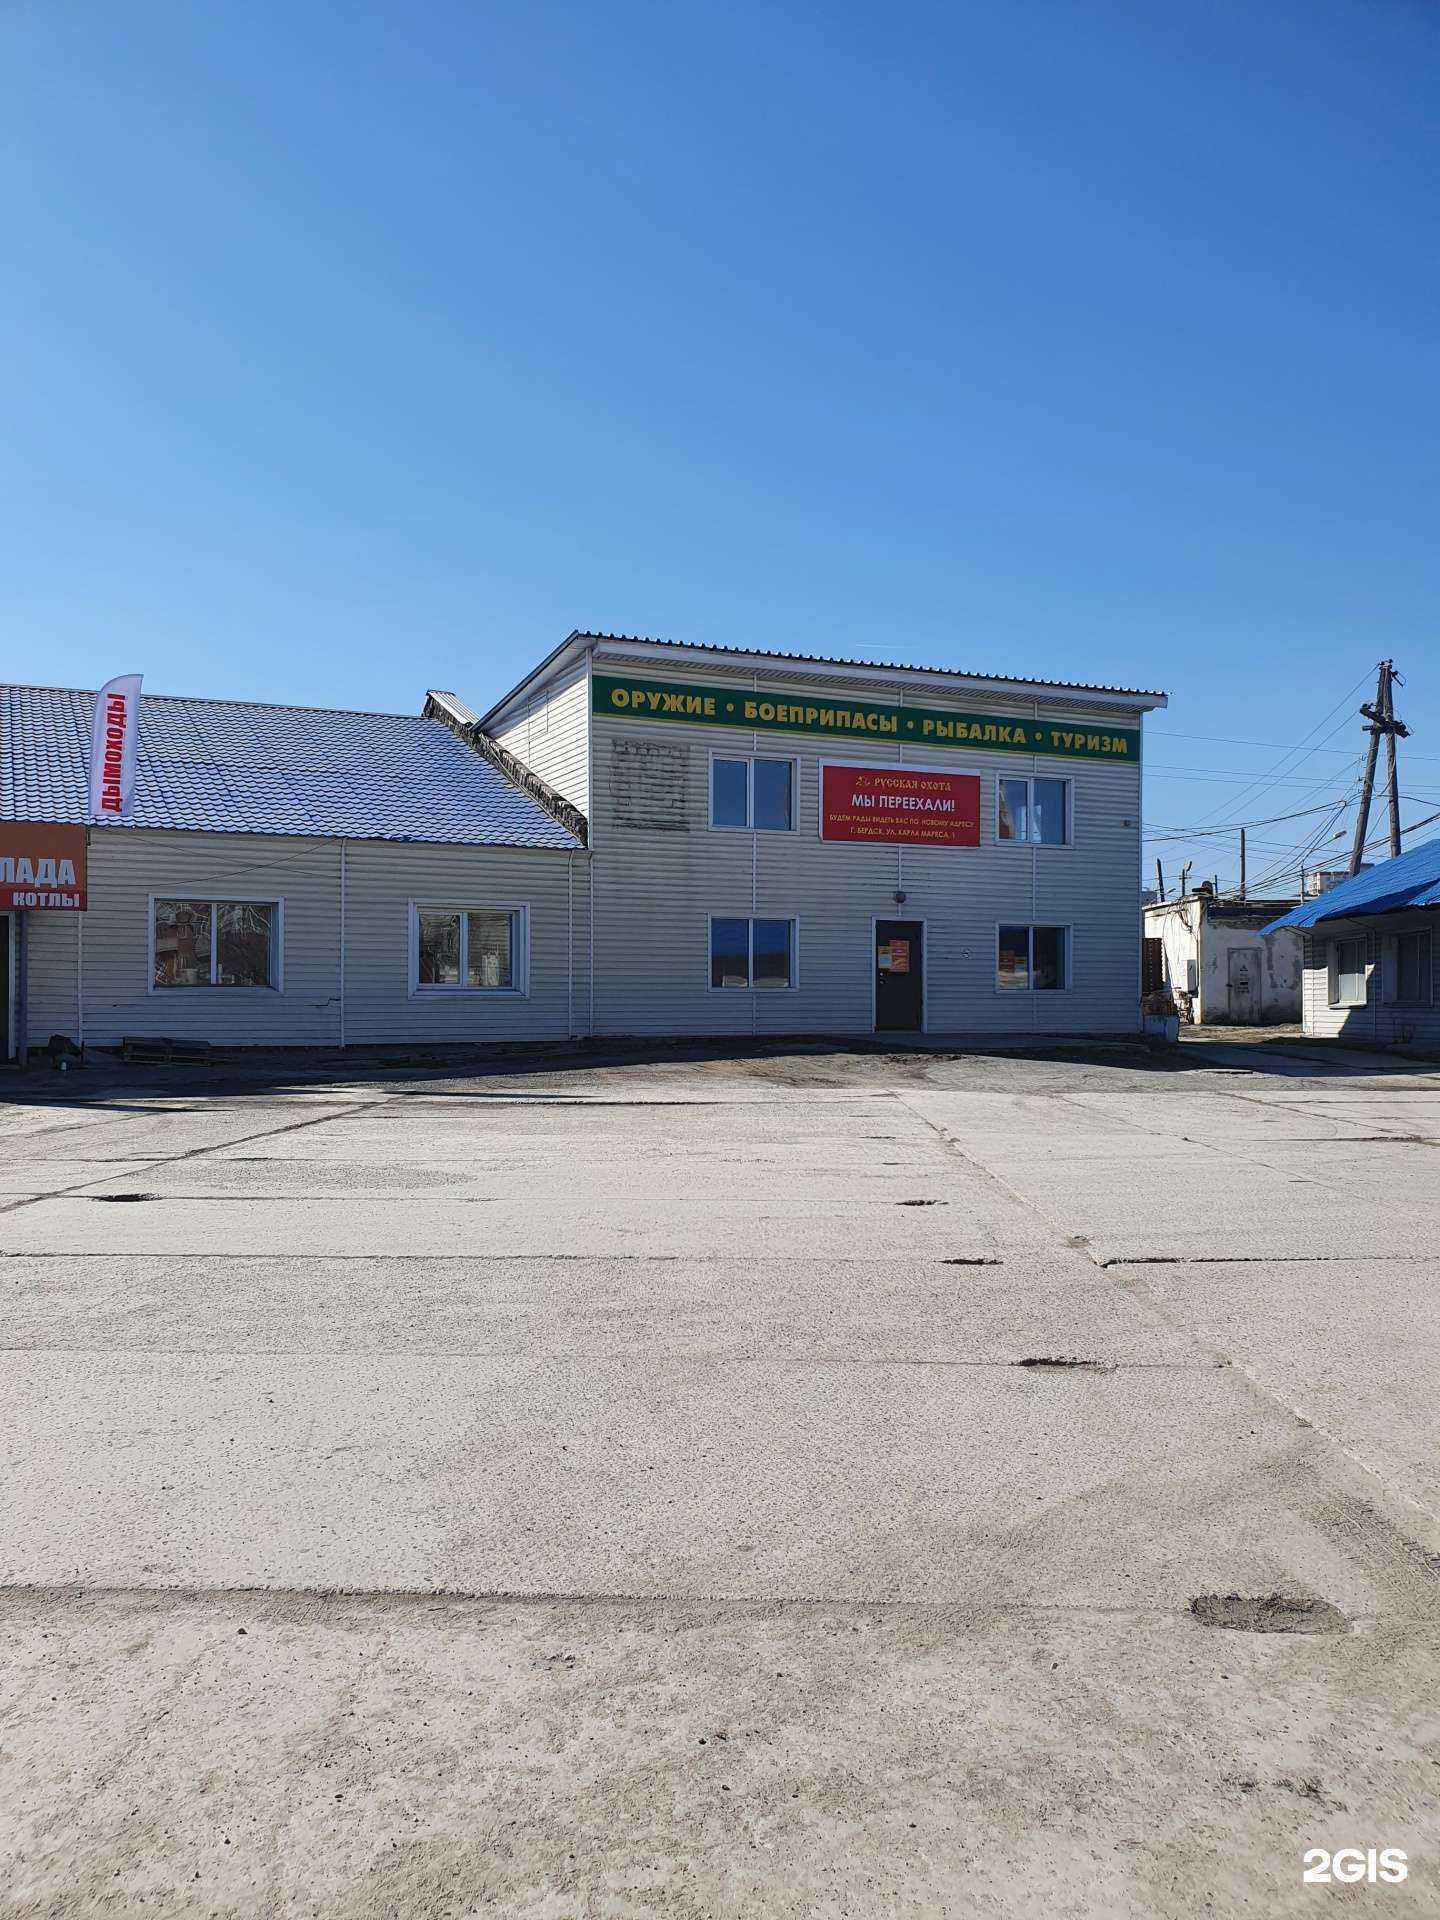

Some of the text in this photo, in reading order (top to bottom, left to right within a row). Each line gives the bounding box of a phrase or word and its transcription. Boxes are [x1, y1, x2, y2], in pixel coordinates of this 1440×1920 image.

[610, 688, 1128, 754] ОРУЖИЕ БОЕПРИПАСЫ РЫБАЛКА ТУРИЗМ
[102, 693, 128, 812] ДЫМОХОДЫ
[874, 778, 952, 792] РУССКАЯ ОХОТА
[851, 794, 955, 812] МЫ ПЕРЕЕХАЛИ!
[829, 814, 850, 822] БУДЕМ
[872, 816, 895, 824] ВИДЕТЬ
[13, 892, 80, 907] КОТЛЫ
